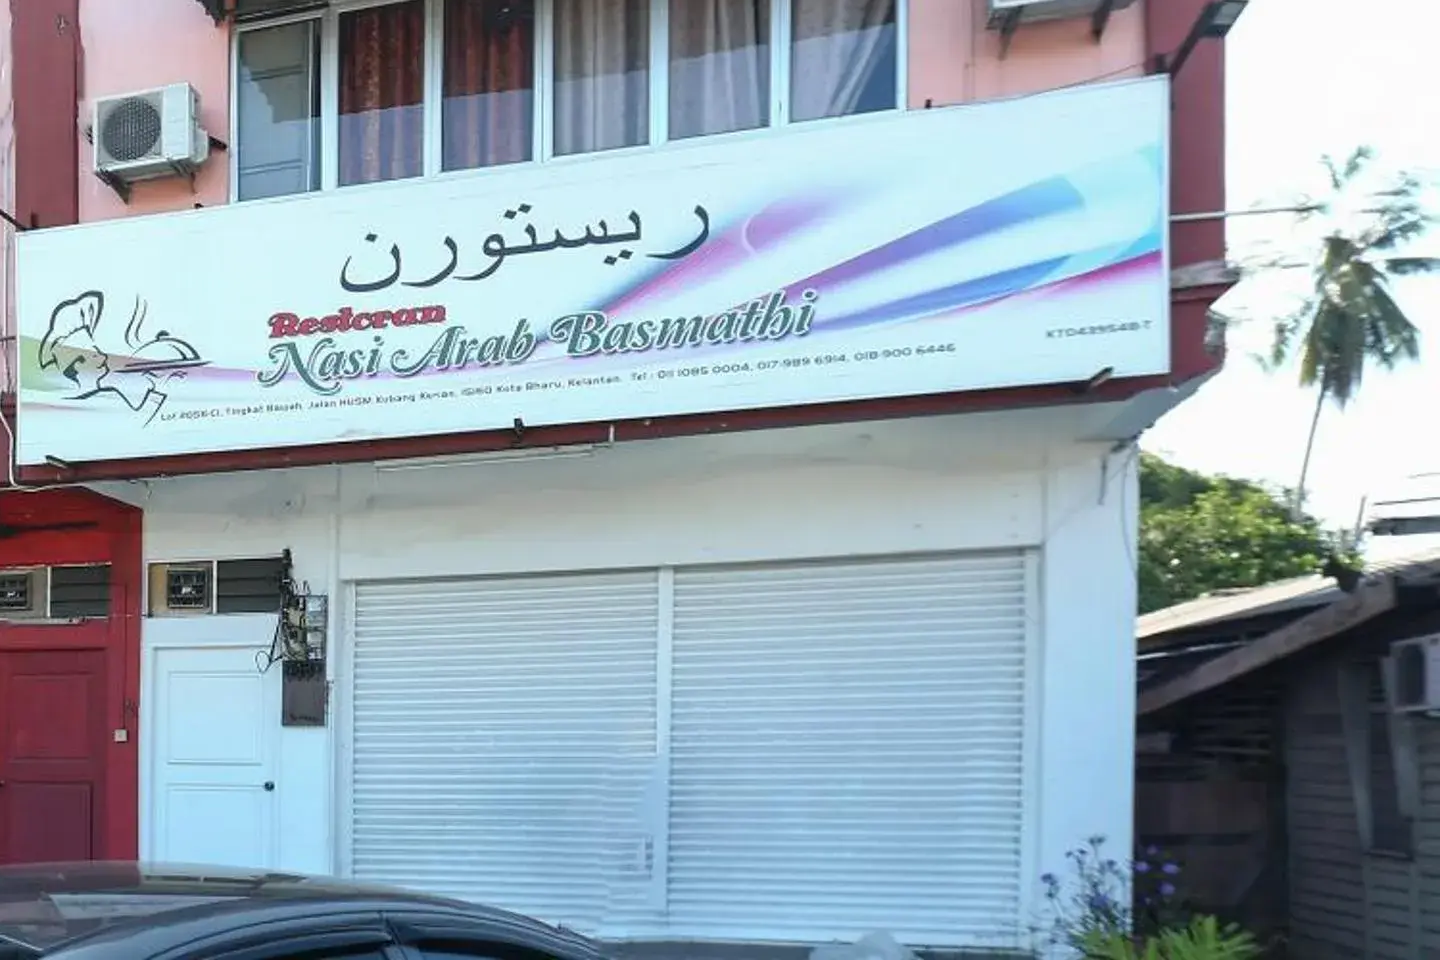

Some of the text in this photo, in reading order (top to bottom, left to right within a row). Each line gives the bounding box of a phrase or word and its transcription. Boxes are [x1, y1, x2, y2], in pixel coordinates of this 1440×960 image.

[257, 290, 818, 396] Nasi Arab Basmathi
[497, 384, 522, 393] Kota
